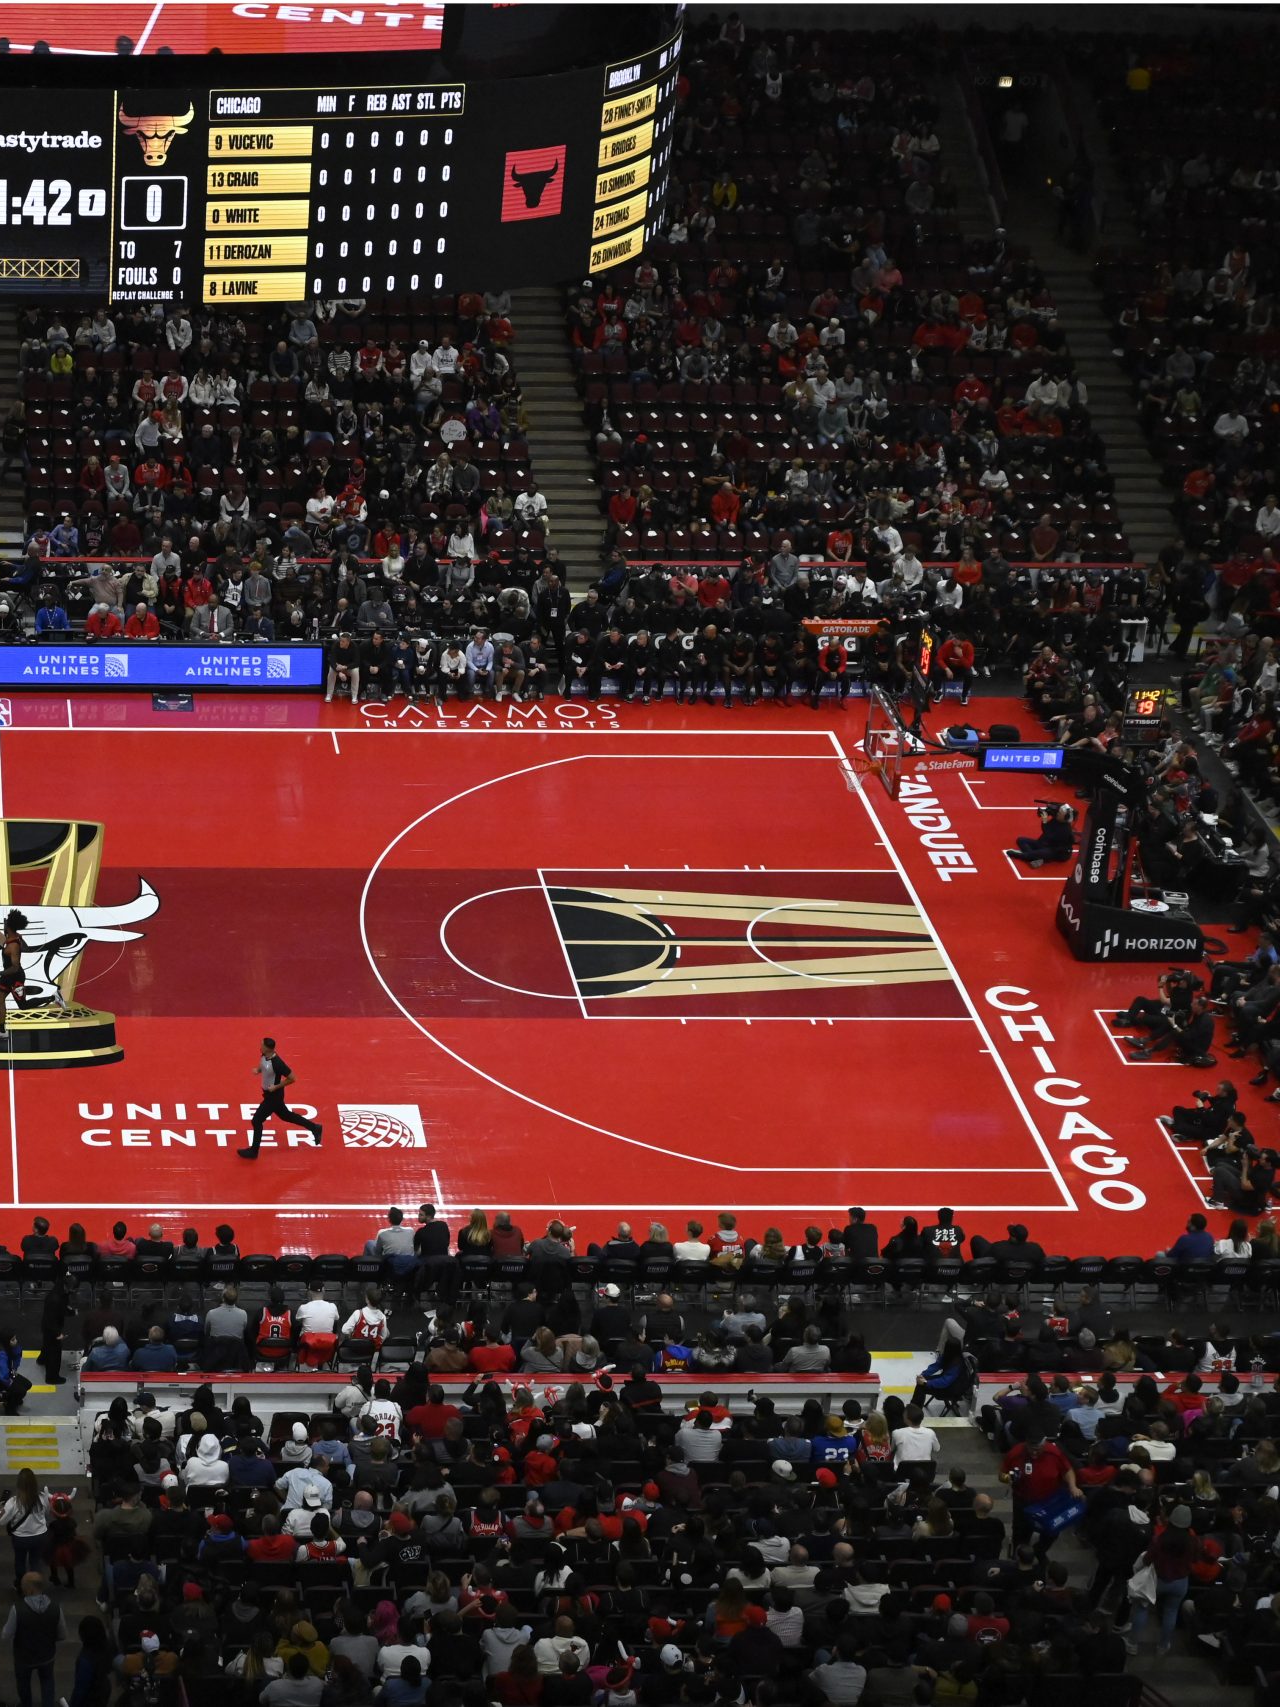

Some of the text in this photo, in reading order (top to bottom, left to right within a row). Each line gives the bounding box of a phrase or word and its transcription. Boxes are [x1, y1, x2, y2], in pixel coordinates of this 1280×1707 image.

[608, 63, 642, 89] BROOKLYN
[216, 92, 461, 114] CHICAGO MIN F REB AST STL PTS
[603, 93, 652, 124] 28 FINNEY-SMITH
[215, 134, 274, 150] 9 VUCEVIC
[611, 135, 637, 158] BRIDGES
[211, 166, 450, 187] 13 CRAIG 0 0 1 0 0 0
[598, 170, 636, 196] 10 SIMMONS
[146, 184, 163, 223] 0
[212, 208, 260, 224] 0 WHITE
[594, 206, 630, 231] 24 THOMAS
[119, 240, 183, 259] TO 7
[208, 244, 272, 260] 11 DEROZAN
[592, 238, 632, 266] 26 DINWIDDIE
[118, 266, 181, 286] FOULS 0
[112, 290, 137, 300] REPLAY
[137, 290, 173, 300] CHALLENGE
[210, 280, 258, 296] 8 LAVINE
[822, 625, 871, 634] GATORADE
[681, 635, 694, 650] G
[843, 636, 857, 652] G
[39, 655, 100, 665] UNITED
[201, 656, 262, 665] UNITED
[23, 666, 100, 676] AIRLINES
[185, 667, 262, 677] AIRLINES
[359, 703, 617, 719] CALAMOS
[1137, 700, 1154, 715] 19
[365, 720, 620, 729] INVESTMENTS
[991, 754, 1041, 763] UNITED
[1103, 774, 1128, 793] coinbase
[1090, 827, 1107, 884] coinbase
[1125, 937, 1198, 950] HORIZON
[984, 986, 1147, 1212] CHICAGO
[81, 1129, 323, 1148] CENTER
[361, 1325, 378, 1338] 44
[374, 1412, 396, 1423] ORDAN
[374, 1423, 395, 1440] 23
